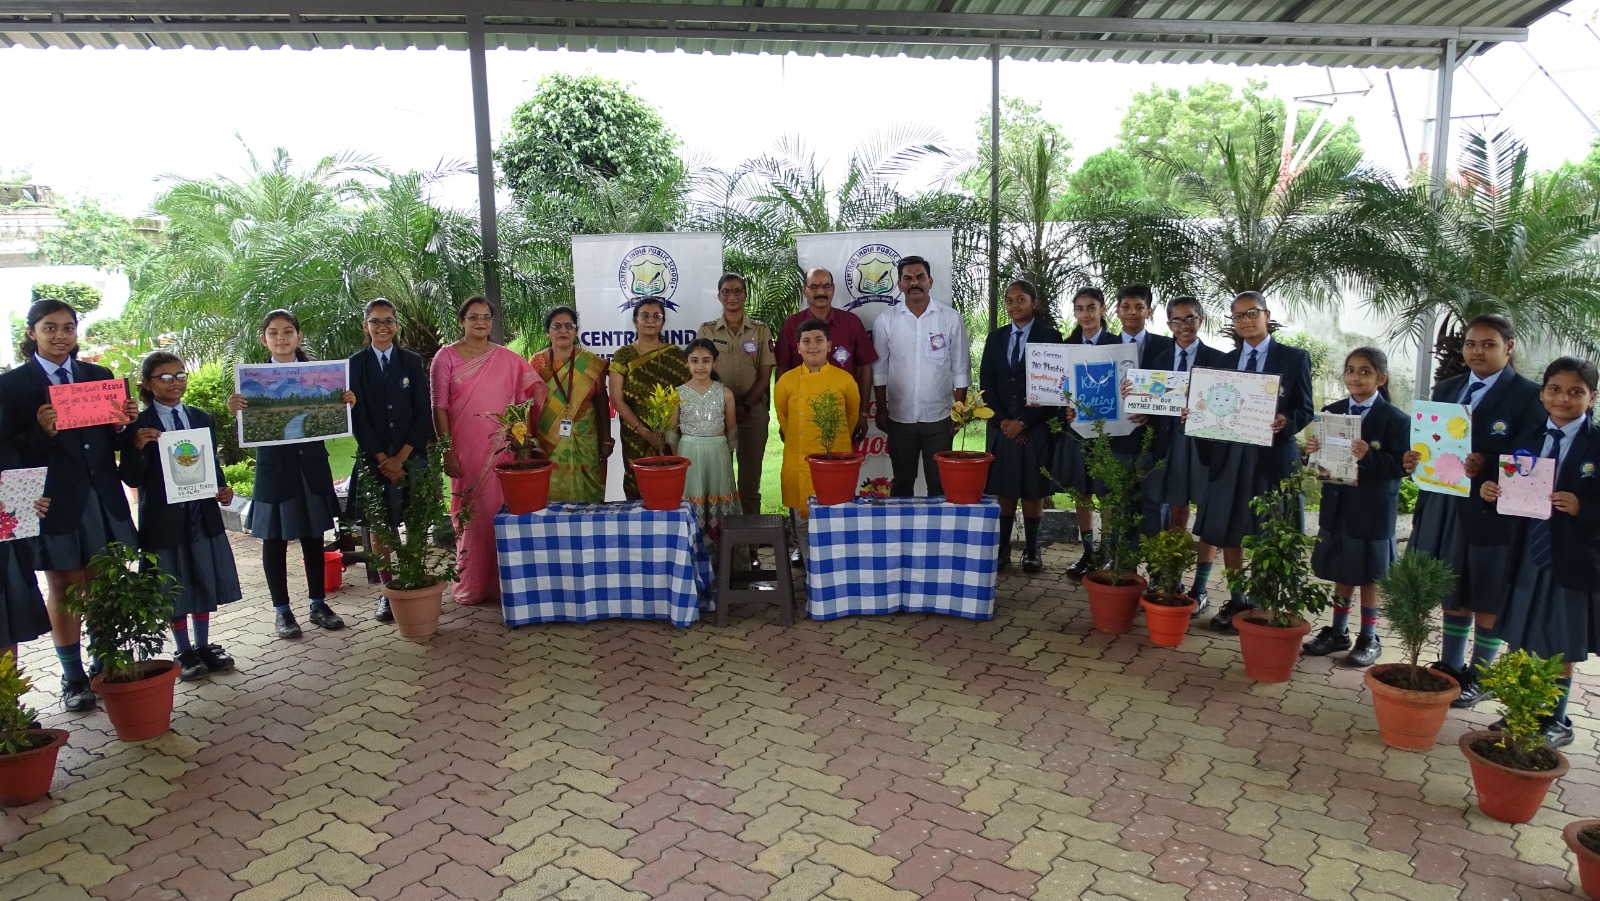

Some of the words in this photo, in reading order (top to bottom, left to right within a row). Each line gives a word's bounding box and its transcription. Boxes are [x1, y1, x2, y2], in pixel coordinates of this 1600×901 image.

[620, 260, 630, 287] CENTRAL
[628, 248, 647, 260] INDIA
[648, 248, 669, 262] PUBLIC
[668, 261, 677, 285] SCHOOL
[846, 258, 857, 286] CENTRAL
[856, 246, 875, 258] INDIA
[876, 246, 898, 260] PUBLIC
[1043, 351, 1062, 359] Green
[1191, 368, 1234, 378] INTERNATIONAL
[102, 382, 123, 391] REUSE
[104, 393, 117, 401] USE
[1127, 402, 1151, 411] MOTHER
[1152, 403, 1168, 412] EARTH
